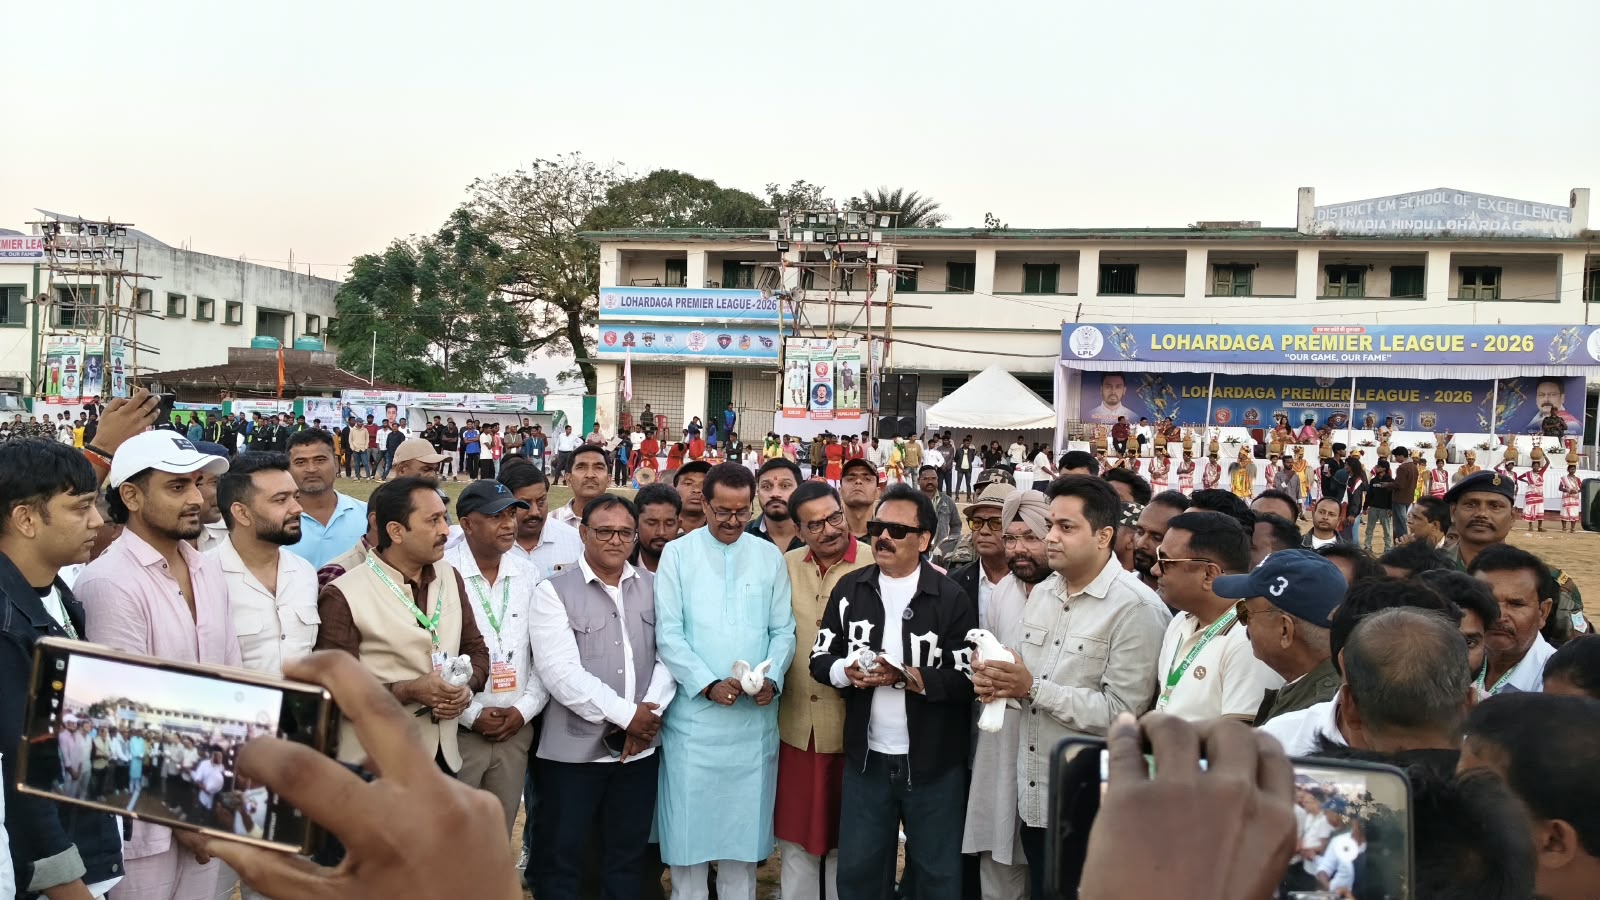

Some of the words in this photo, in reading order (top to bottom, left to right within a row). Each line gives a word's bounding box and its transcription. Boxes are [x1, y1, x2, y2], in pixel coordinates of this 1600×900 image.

[1317, 203, 1373, 221] DISTRICT
[1377, 199, 1396, 213] CM
[1400, 192, 1449, 209] SCHOOL
[1454, 193, 1472, 207] OF
[1478, 197, 1568, 221] EXCELLENCE
[26, 239, 43, 250] LEA
[621, 296, 673, 308] LOHARDAGA
[675, 296, 714, 309] PREMIER
[1150, 333, 1275, 351] LOHARDAGA
[1281, 334, 1373, 352] PREMIER
[1380, 334, 1465, 353] LEAGUE
[1483, 334, 1535, 353] 2026
[1310, 353, 1339, 362] GAME,
[1341, 353, 1361, 361] OUR
[1181, 385, 1277, 400] LOHARDAGA
[1281, 387, 1351, 401] PREMIER
[1356, 389, 1420, 402] LEAGUE
[1434, 390, 1473, 403] 2026
[1269, 576, 1289, 597] 3
